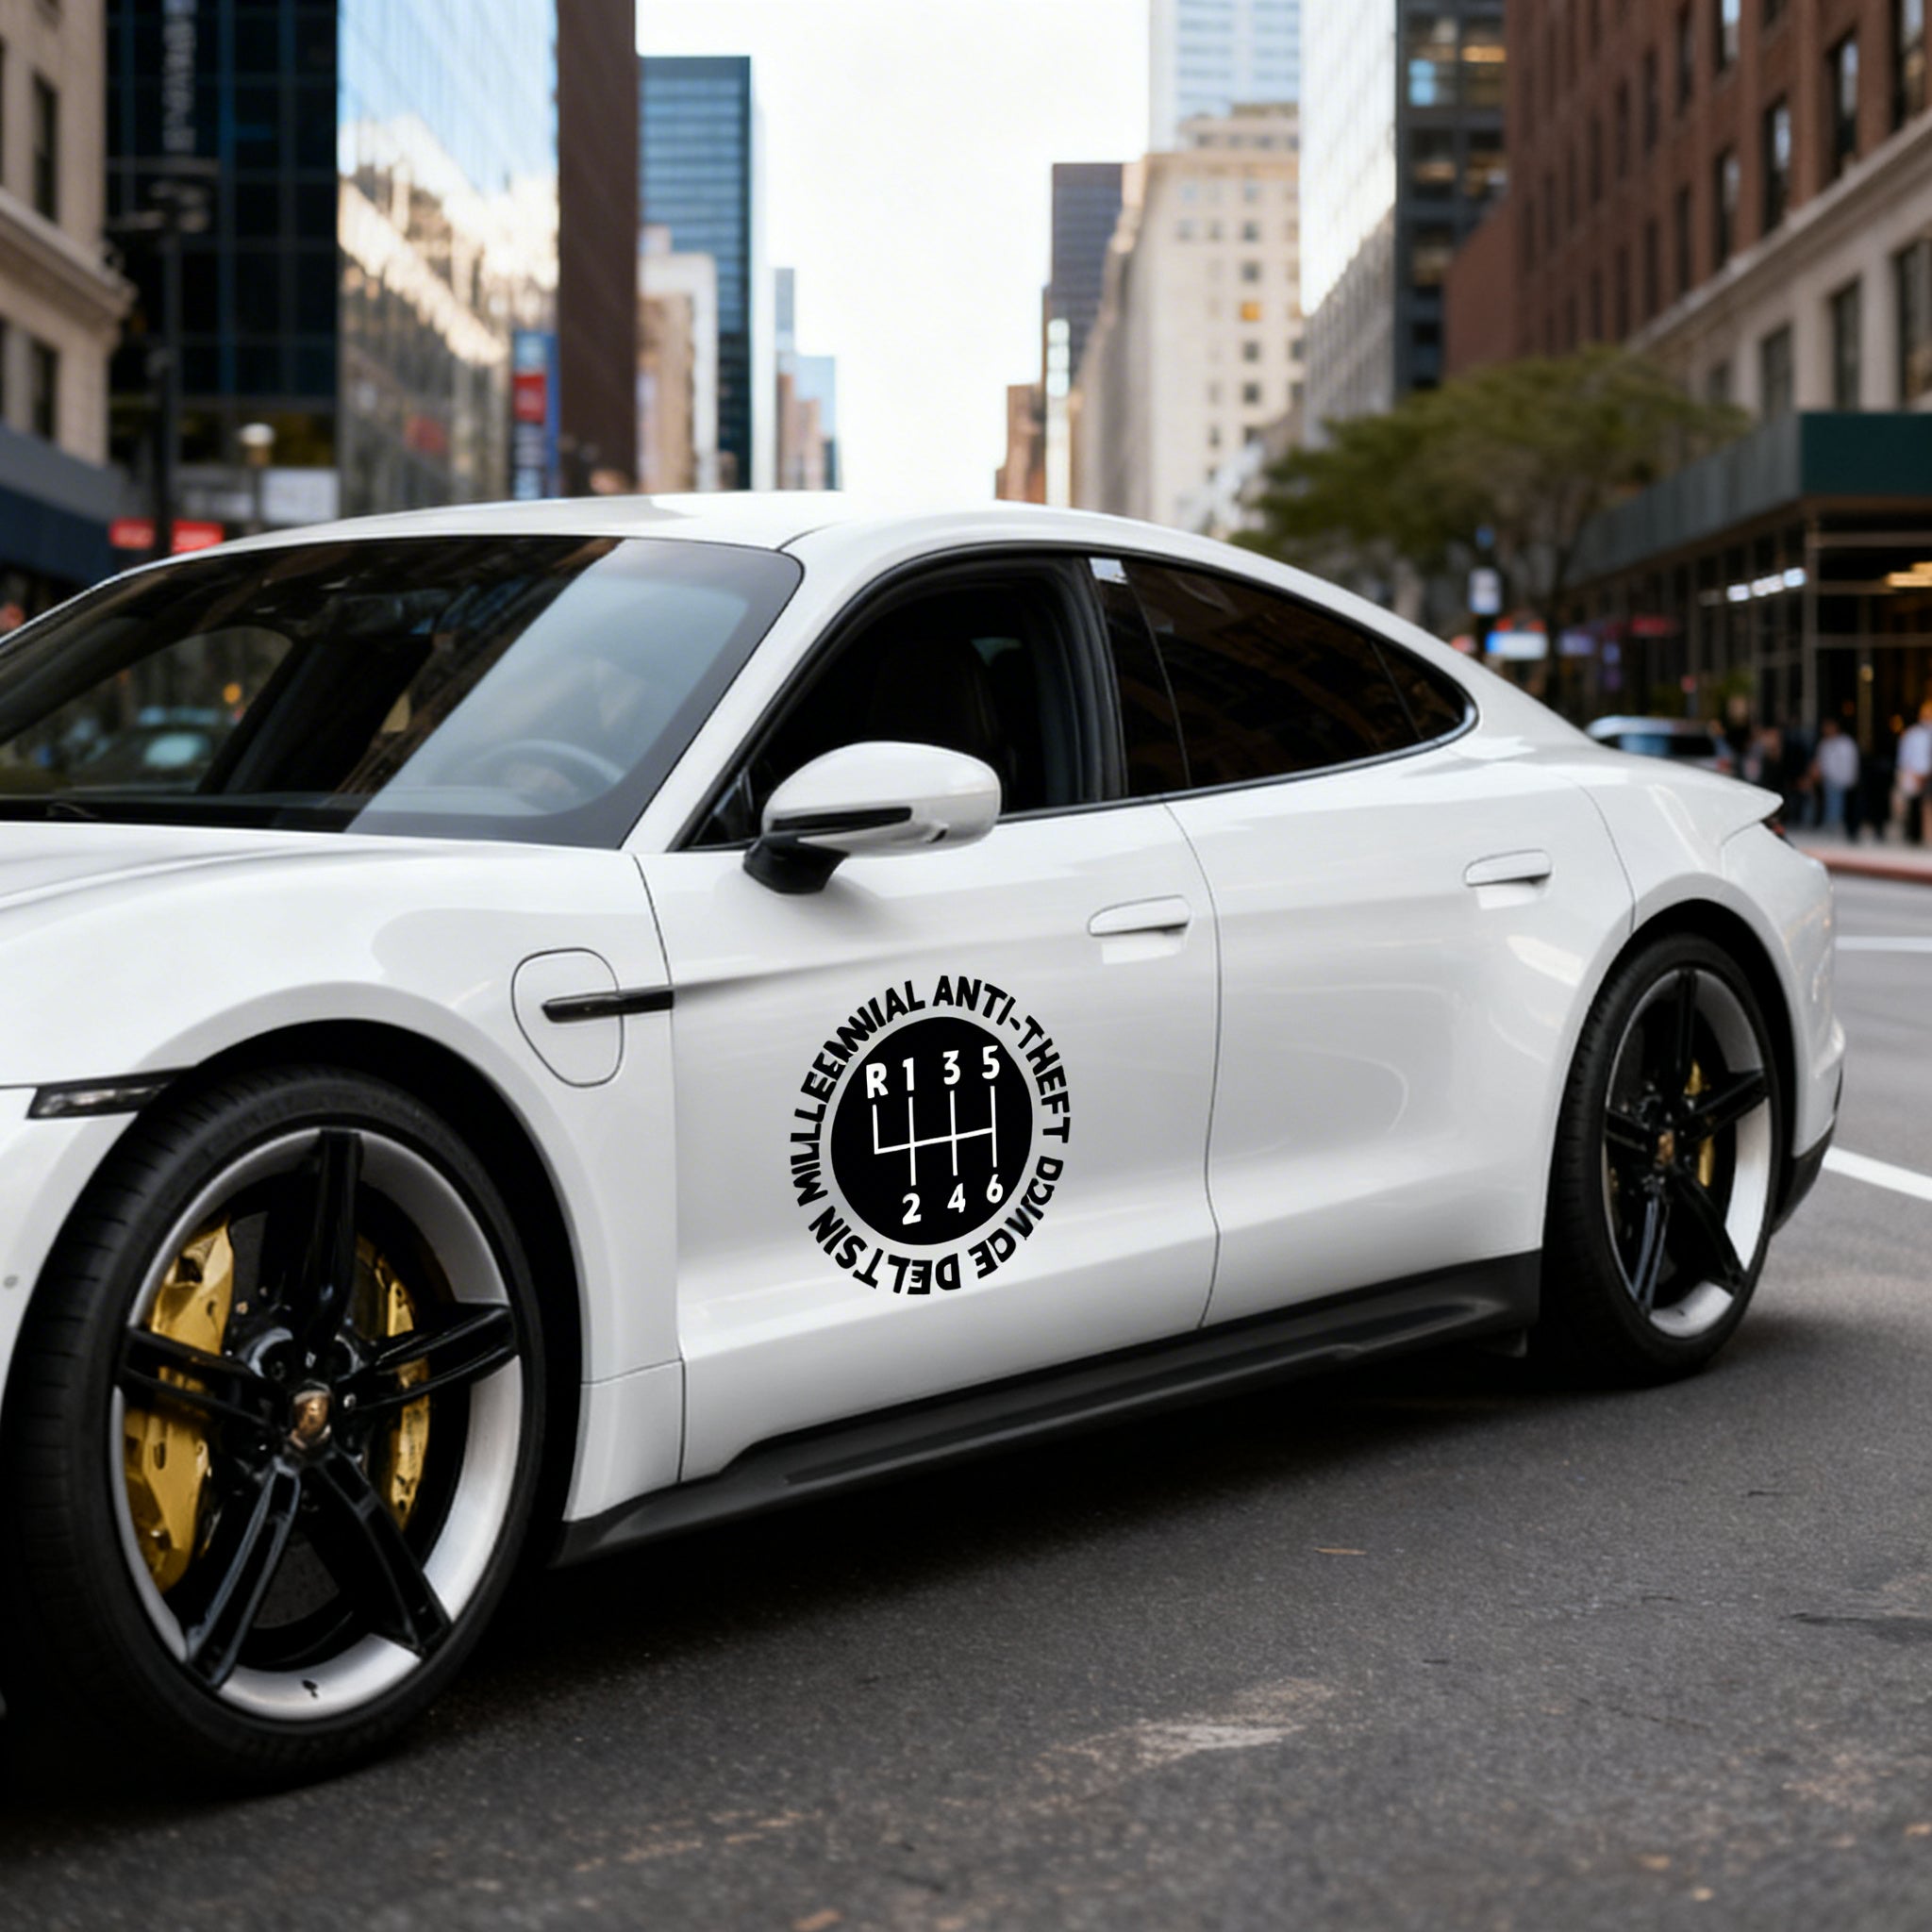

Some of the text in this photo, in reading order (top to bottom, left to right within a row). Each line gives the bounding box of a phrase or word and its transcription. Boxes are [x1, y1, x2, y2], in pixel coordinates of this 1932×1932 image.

[865, 1044, 1000, 1099] R 1 3 5
[932, 974, 1071, 1144] ANTI-THEFT
[902, 1174, 1004, 1225] 2 4 6
[808, 1205, 961, 1295] DELTSIN
